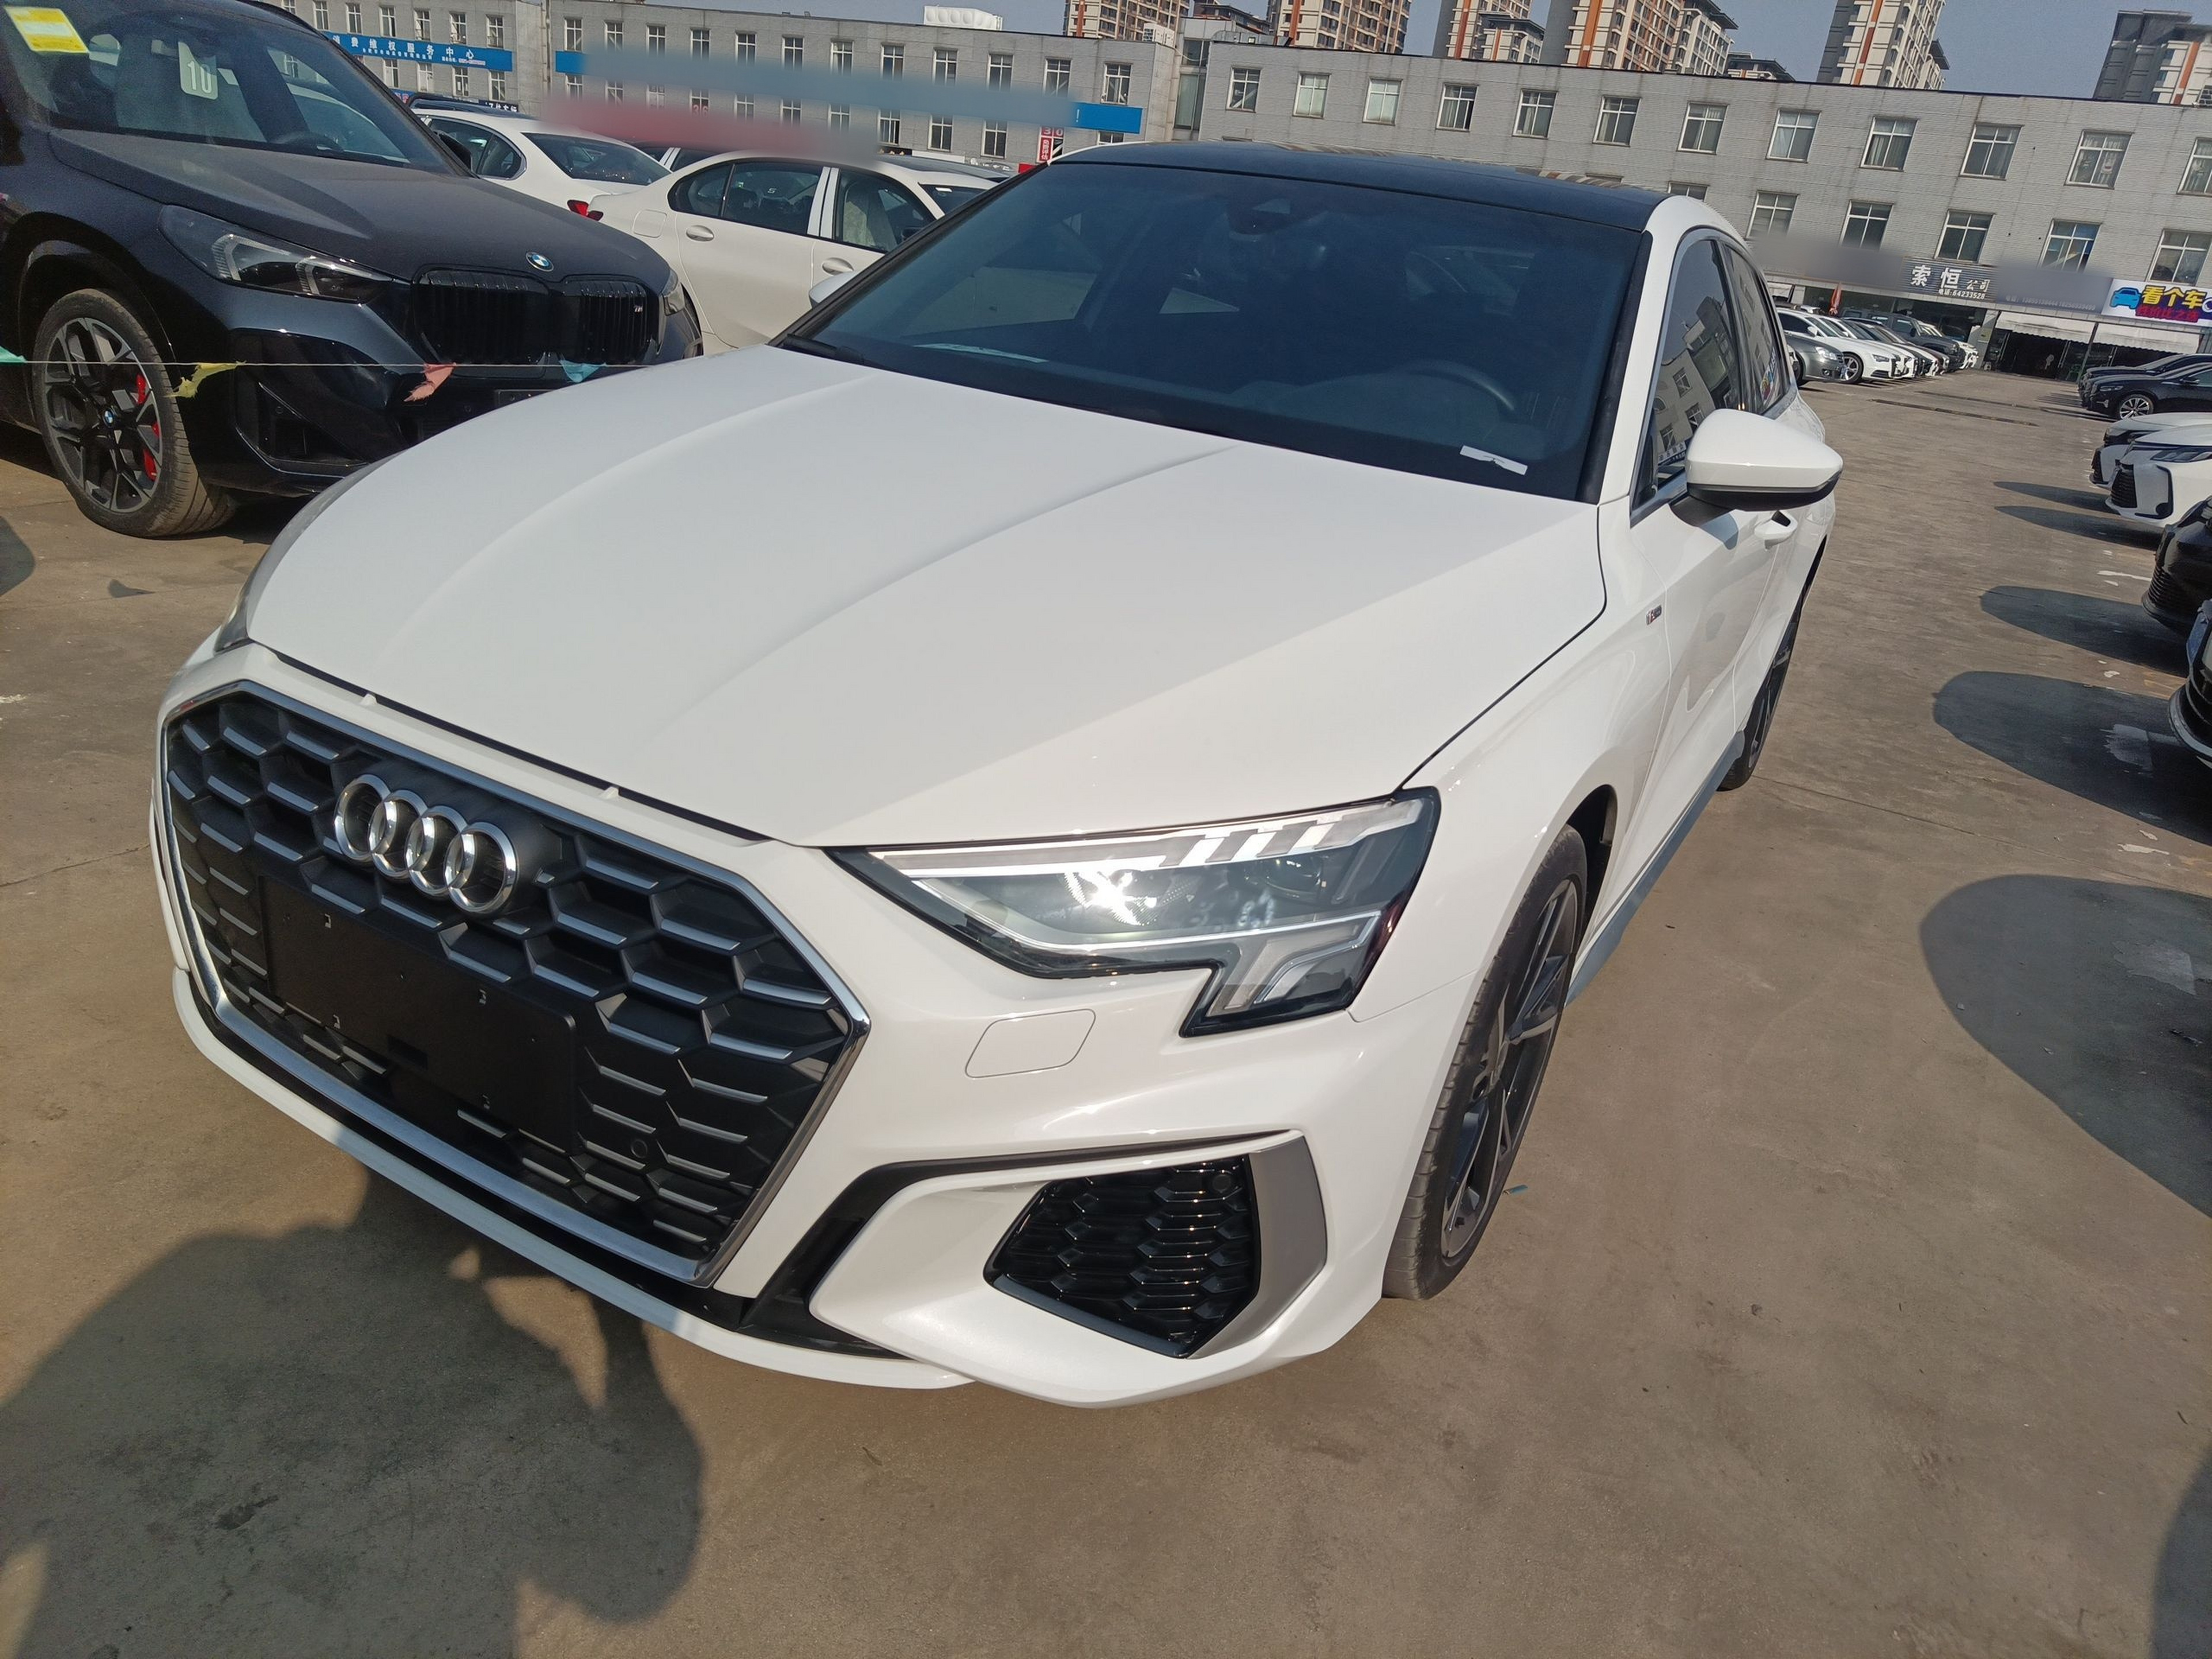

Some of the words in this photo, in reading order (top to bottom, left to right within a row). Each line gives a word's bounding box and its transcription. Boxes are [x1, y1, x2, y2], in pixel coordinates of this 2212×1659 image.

[187, 60, 212, 93] 10
[2142, 285, 2207, 309] 看个车
